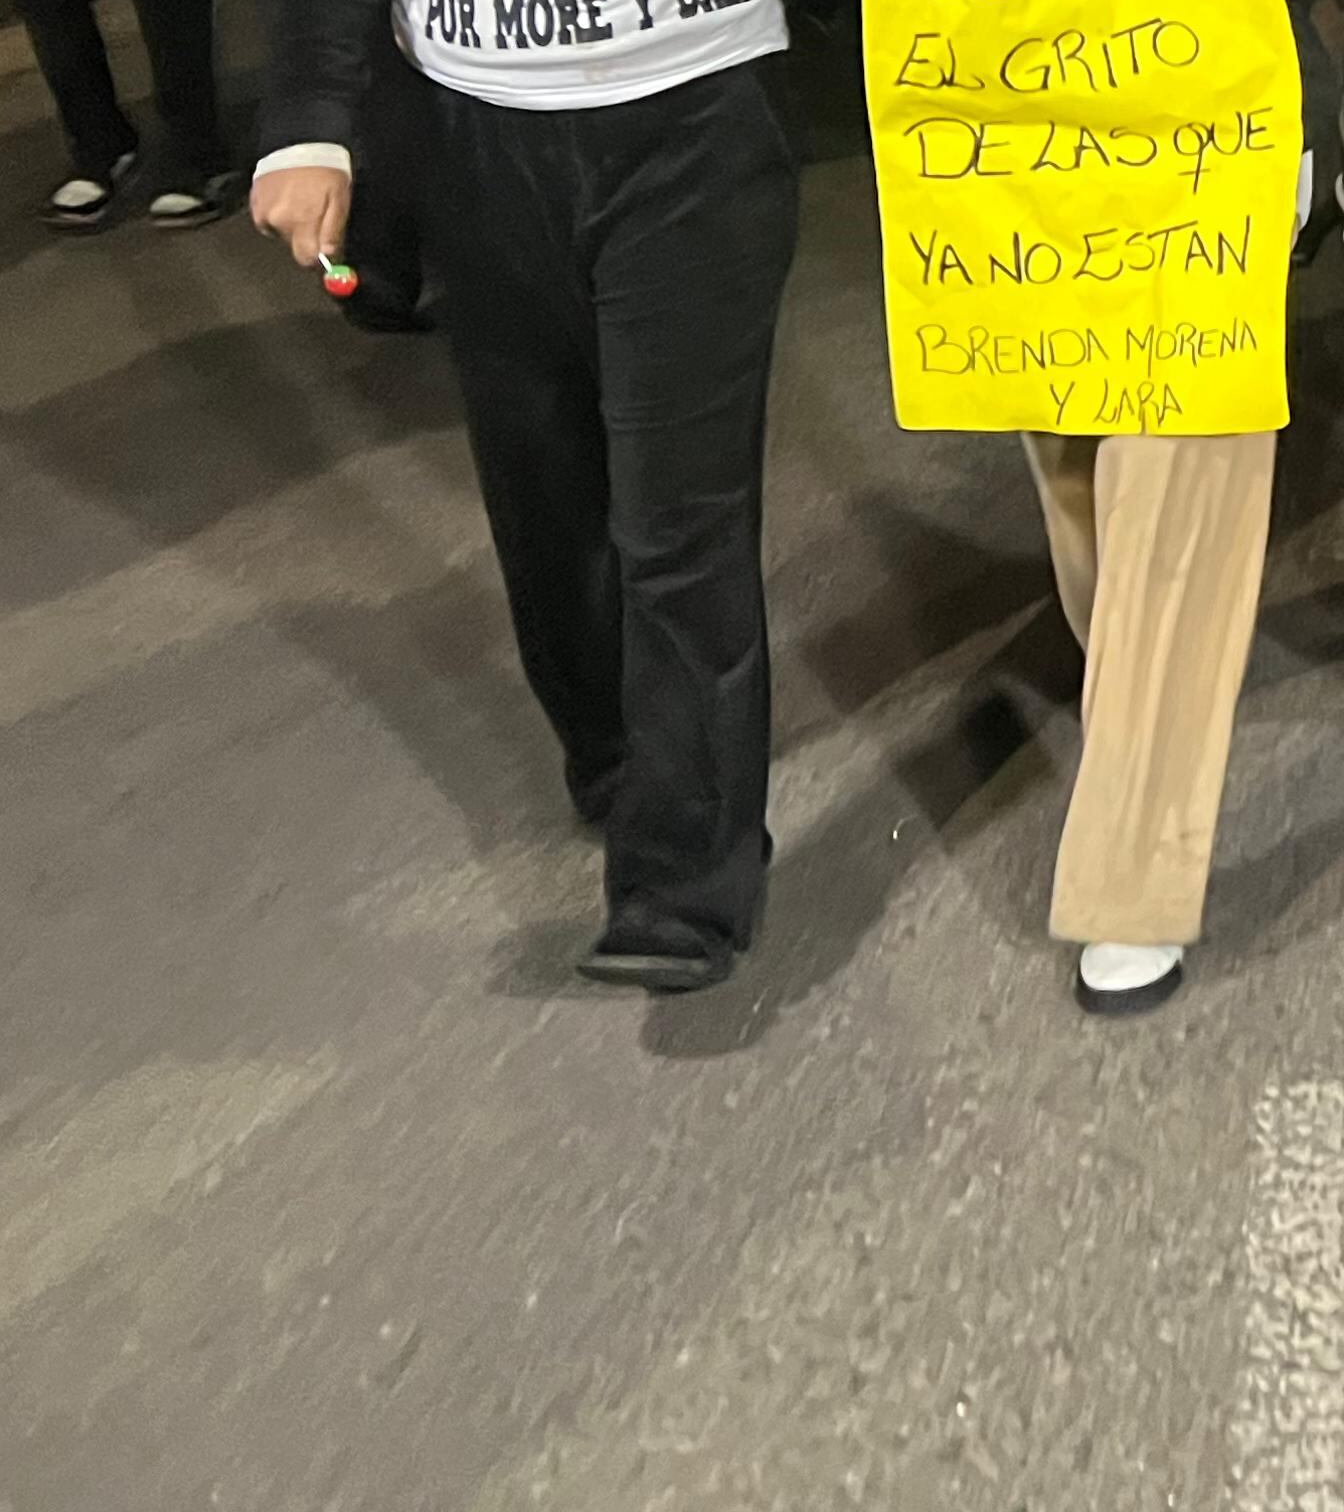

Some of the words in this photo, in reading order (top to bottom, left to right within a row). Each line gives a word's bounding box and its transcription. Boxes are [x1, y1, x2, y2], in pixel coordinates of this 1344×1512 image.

[896, 33, 985, 89] EL
[1000, 18, 1199, 93] GRITO
[904, 117, 1013, 179] DE
[1030, 120, 1157, 171] LAS
[1173, 107, 1275, 195] QUE
[909, 230, 973, 285] YA
[990, 231, 1061, 285] NO
[1073, 215, 1251, 281] ESTAN
[915, 324, 1110, 376] BRENDA
[1125, 318, 1257, 378] MORENA
[1050, 381, 1075, 425] Y
[1092, 379, 1183, 428] LARA
